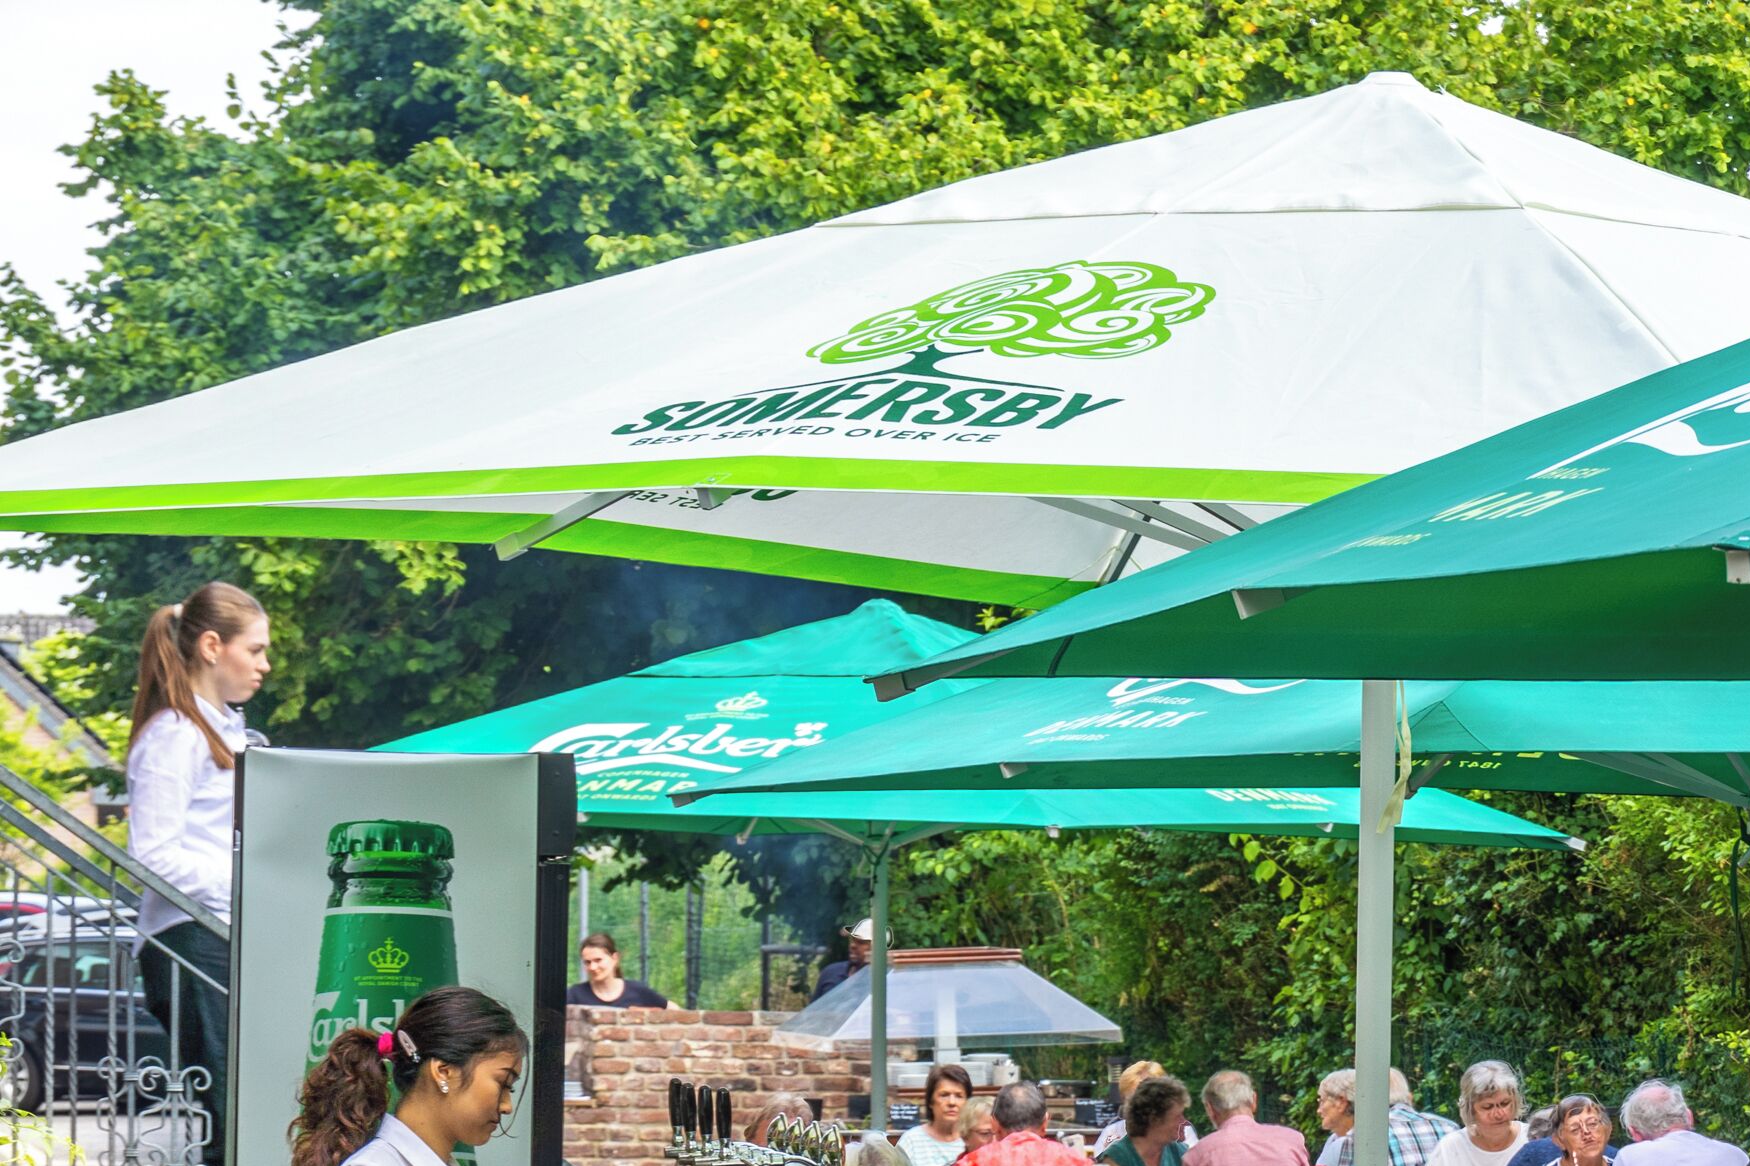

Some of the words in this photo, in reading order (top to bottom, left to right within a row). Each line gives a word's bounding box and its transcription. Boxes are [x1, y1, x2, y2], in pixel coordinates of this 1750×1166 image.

[611, 378, 1125, 434] SOMERSBY
[629, 431, 710, 447] BEST
[711, 425, 835, 442] SERVED
[844, 428, 934, 443] OVER
[943, 432, 1001, 444] ICE
